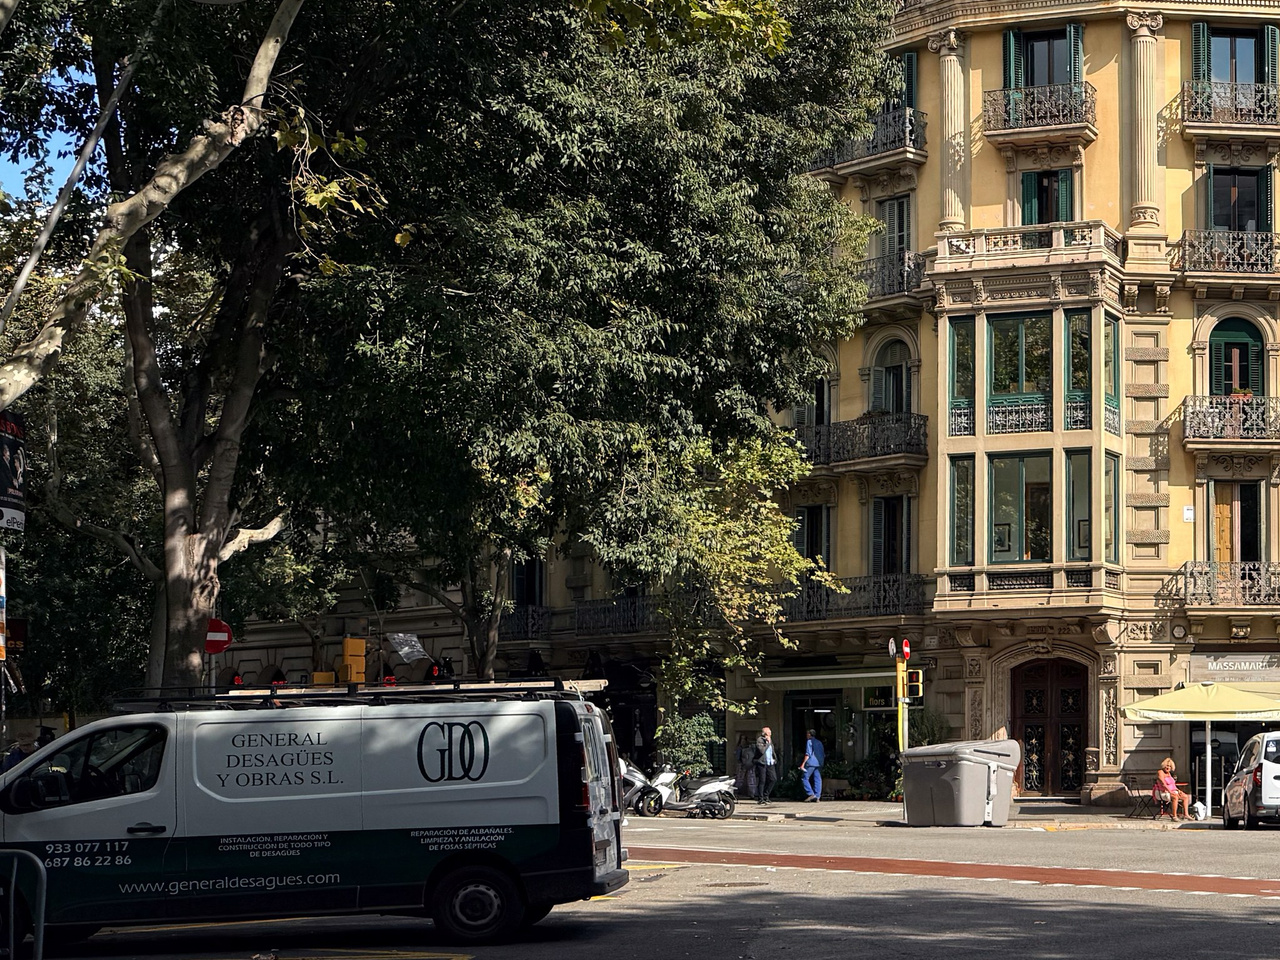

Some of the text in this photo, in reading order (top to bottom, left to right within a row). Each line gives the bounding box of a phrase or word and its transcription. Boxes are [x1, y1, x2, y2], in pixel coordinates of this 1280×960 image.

[1057, 627, 1071, 635] 222
[1208, 661, 1270, 671] MASSAMARA
[231, 732, 328, 748] GENERAL
[226, 749, 334, 768] DESAGÜES
[216, 770, 344, 787] Y OBRAS S.L.
[274, 833, 322, 842] REPARACIÓN
[410, 829, 458, 837] REPARACIÓN
[460, 835, 505, 843] ANULACIÓN
[45, 841, 129, 854] 933 077 117
[218, 842, 277, 851] CONSTRUCCIÓN
[464, 842, 497, 850] SÉPTICAS
[261, 849, 301, 857] DESAGÜES
[44, 855, 132, 868] 687 86 22 86
[118, 873, 341, 895] www.generaldesagues.com
